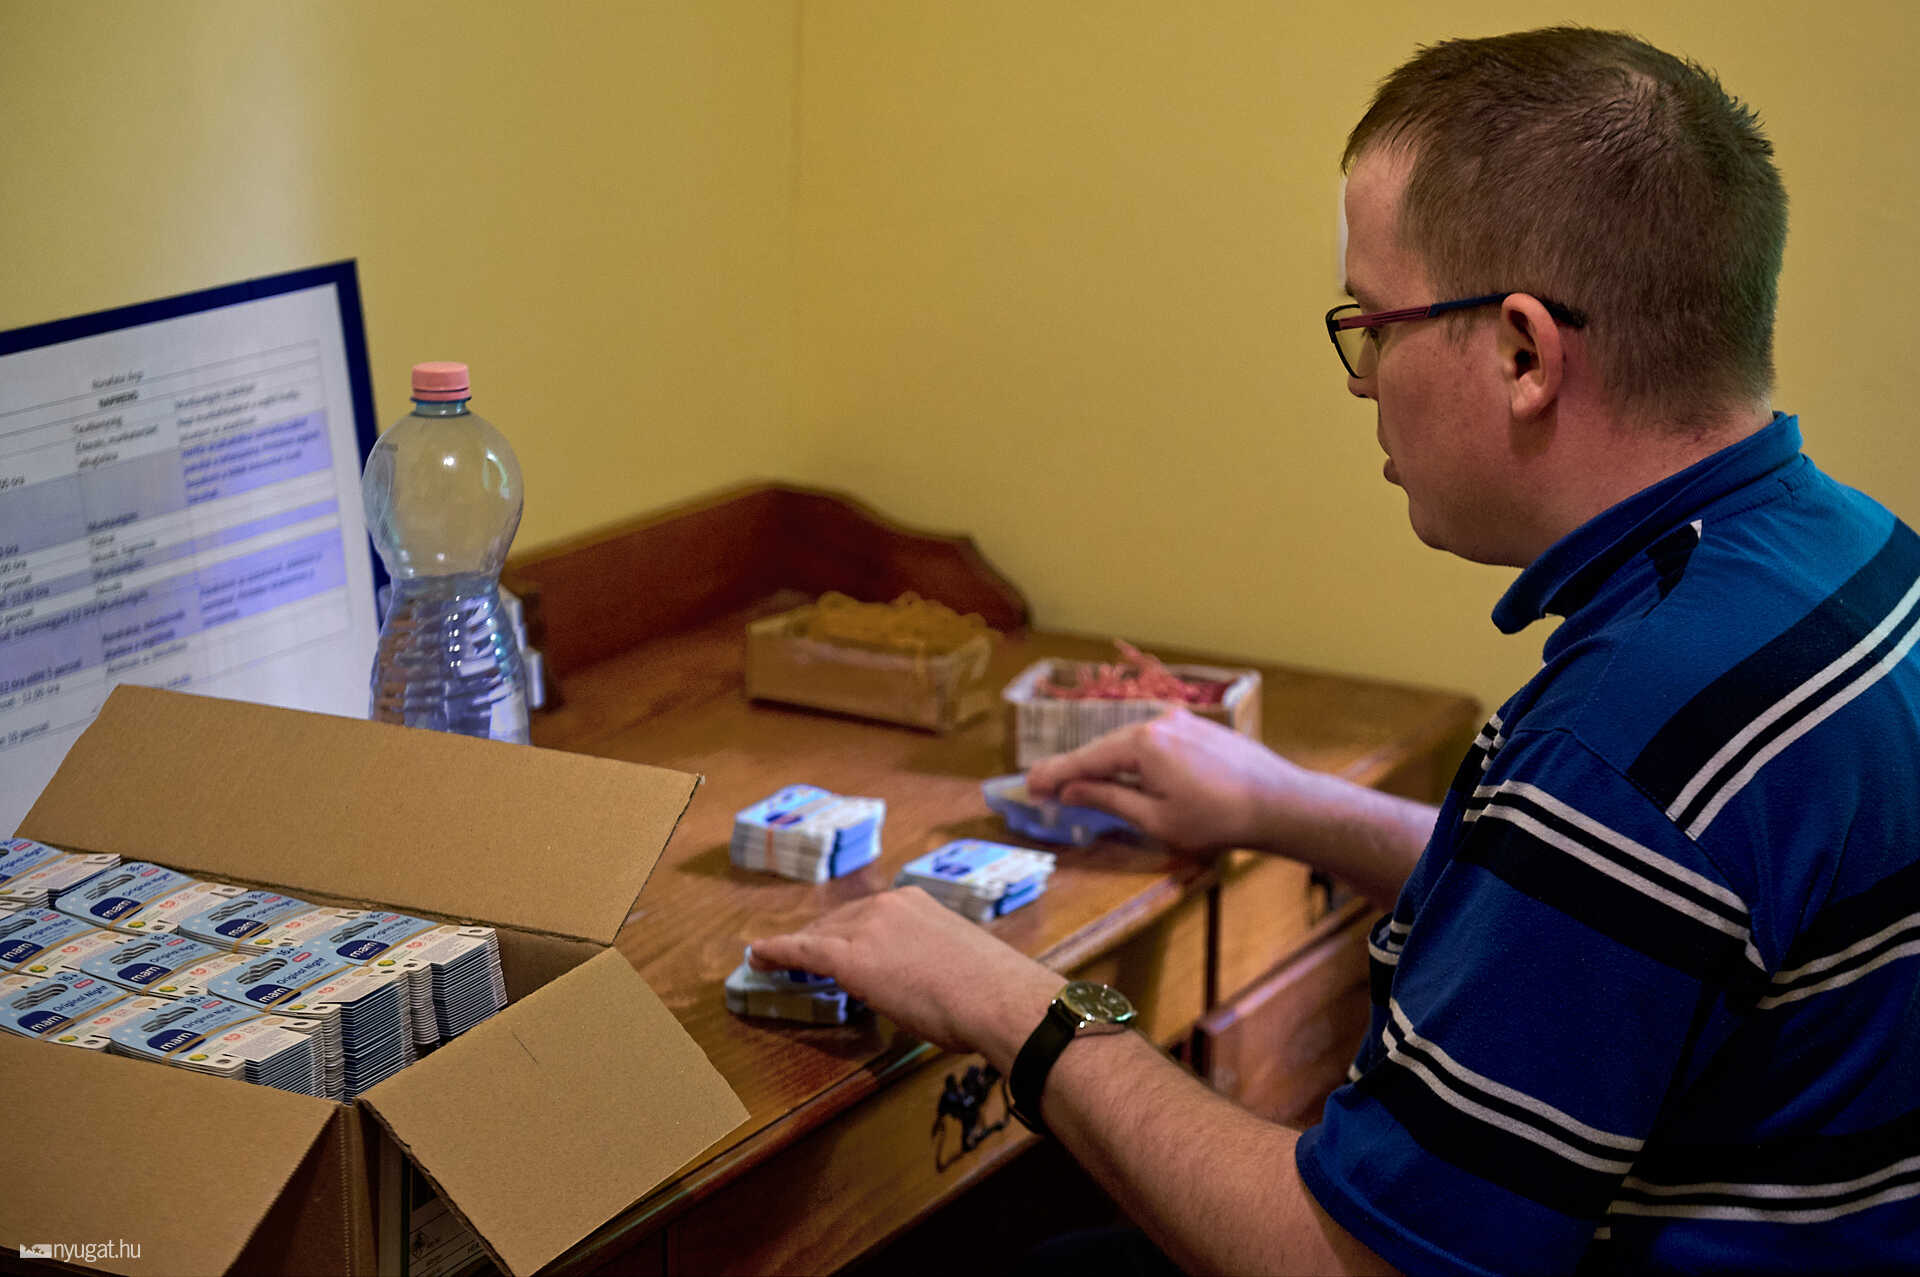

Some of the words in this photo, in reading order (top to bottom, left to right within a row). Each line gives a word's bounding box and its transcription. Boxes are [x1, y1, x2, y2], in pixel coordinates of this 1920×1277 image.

[2, 942, 33, 960] mam
[131, 966, 161, 982] mam
[259, 987, 288, 1003] mam
[31, 1015, 64, 1032] mam
[160, 1032, 193, 1051] mam
